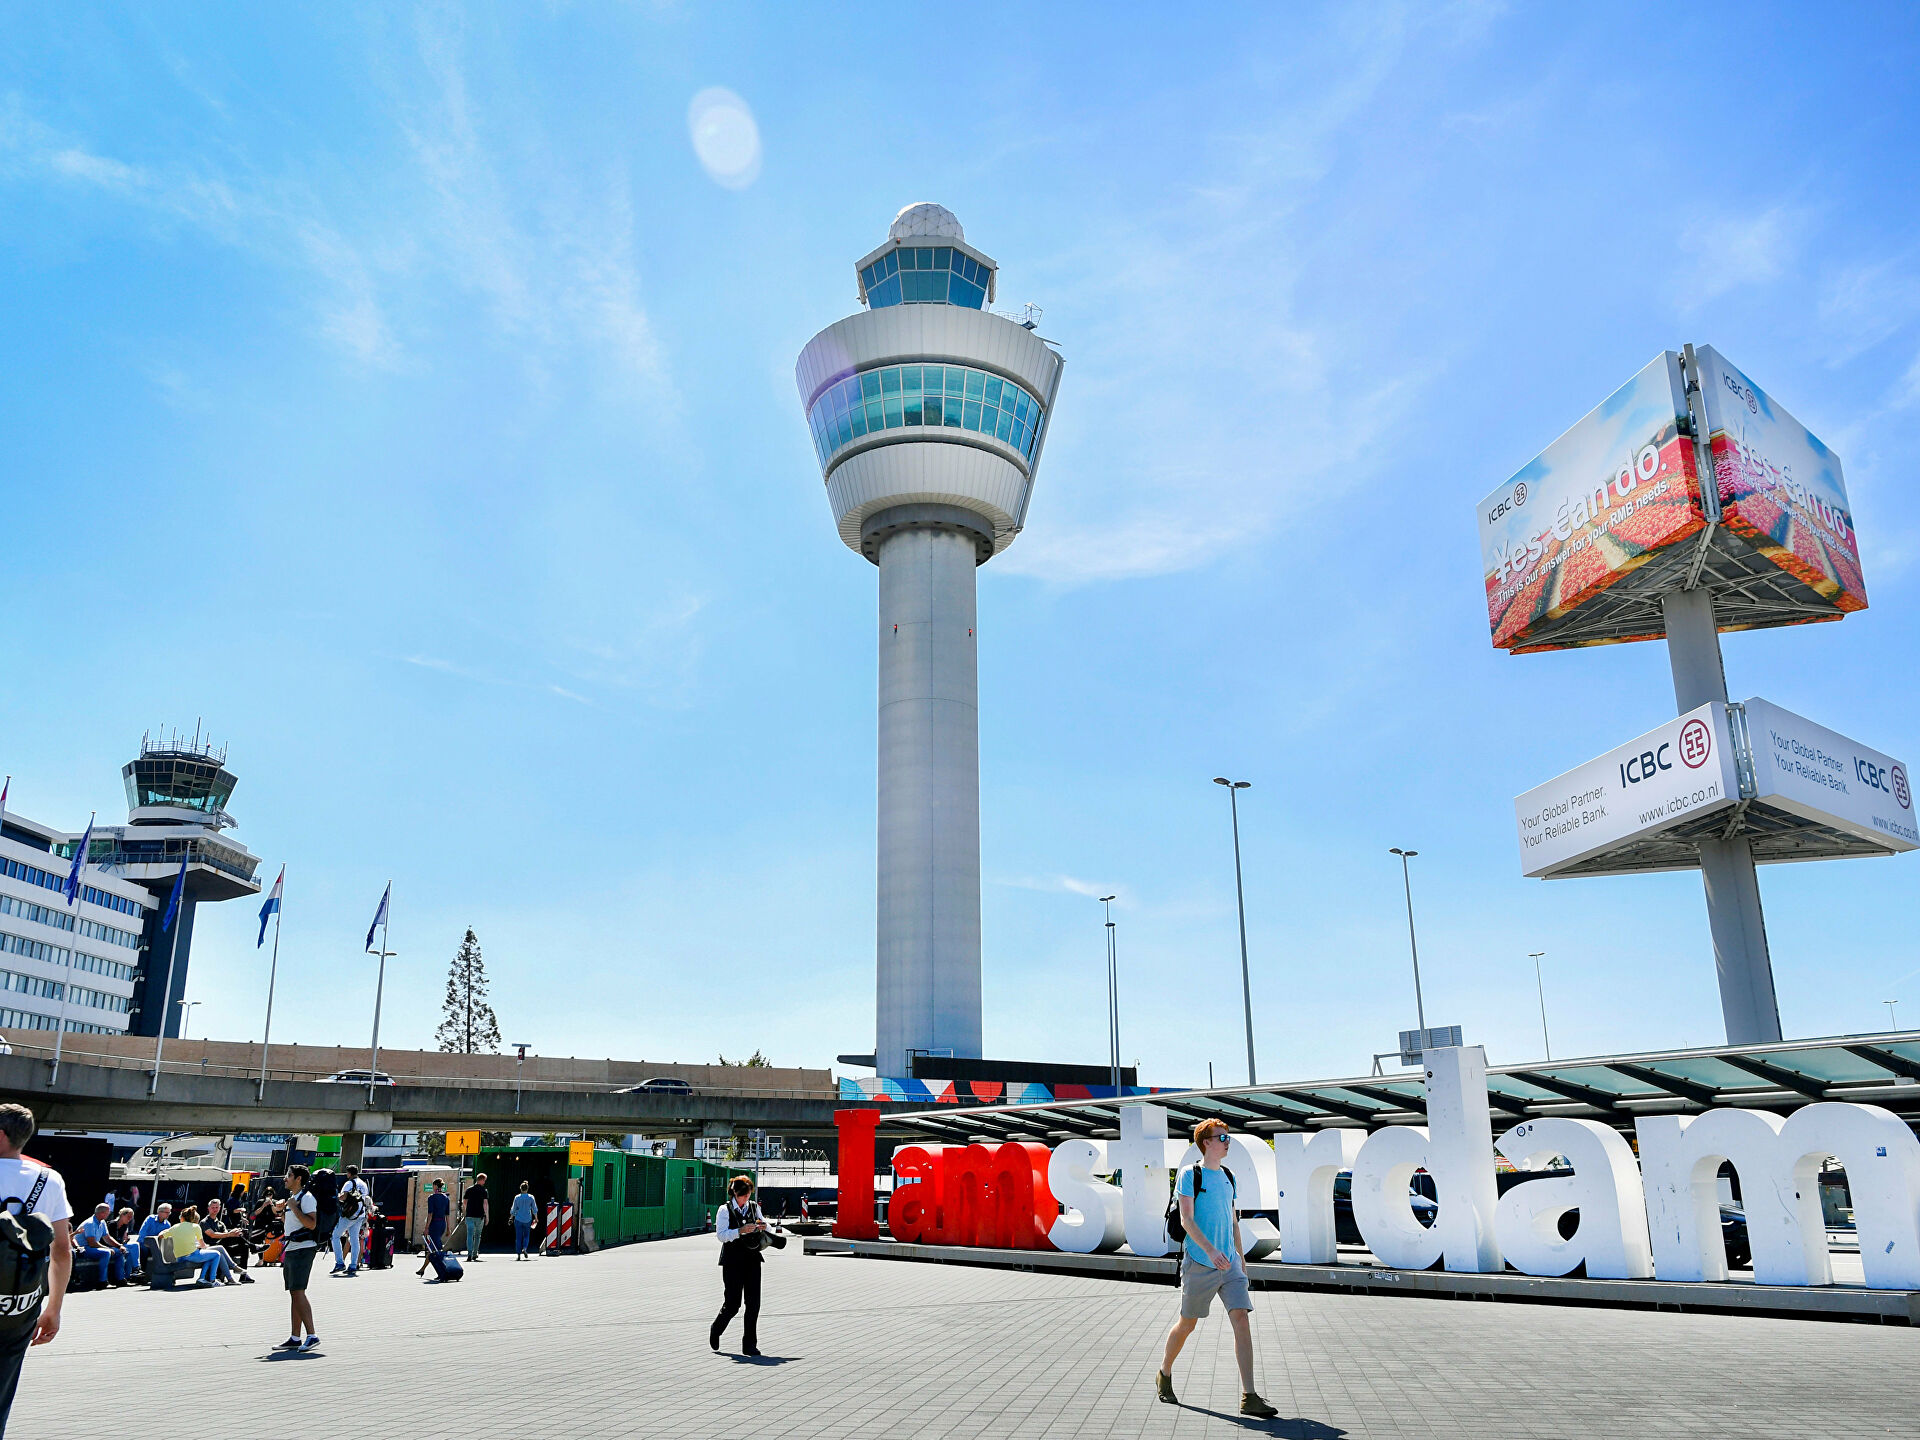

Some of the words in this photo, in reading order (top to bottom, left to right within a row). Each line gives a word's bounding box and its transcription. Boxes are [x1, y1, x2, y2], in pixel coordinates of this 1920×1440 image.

[1722, 371, 1745, 400] ICBC
[1615, 443, 1668, 497] do.
[1488, 497, 1512, 525] ICBC
[1497, 586, 1515, 603] This
[1516, 580, 1524, 592] is
[1525, 568, 1539, 586] our
[1540, 546, 1571, 575] answer
[1571, 534, 1587, 553] for
[1586, 520, 1609, 548] your
[1609, 501, 1634, 528] RMB
[1635, 479, 1671, 510] needs.
[1620, 742, 1673, 789] ICBC
[1769, 729, 1790, 751] Your
[1791, 739, 1817, 761] Global
[1816, 749, 1847, 775] Partner.
[1773, 751, 1794, 773] Your
[1795, 760, 1827, 787] Reliable
[1828, 773, 1850, 795] Bank.
[1853, 755, 1890, 794] ICBC
[1520, 813, 1541, 831] Your
[1541, 798, 1570, 822] Global
[1570, 785, 1607, 812] Partner.
[1638, 780, 1720, 825] www.icbc.co.nl
[1522, 830, 1544, 849] Your
[1544, 816, 1581, 839] Reliable
[1582, 804, 1609, 826] Bank.
[31, 1181, 44, 1202] HUGO
